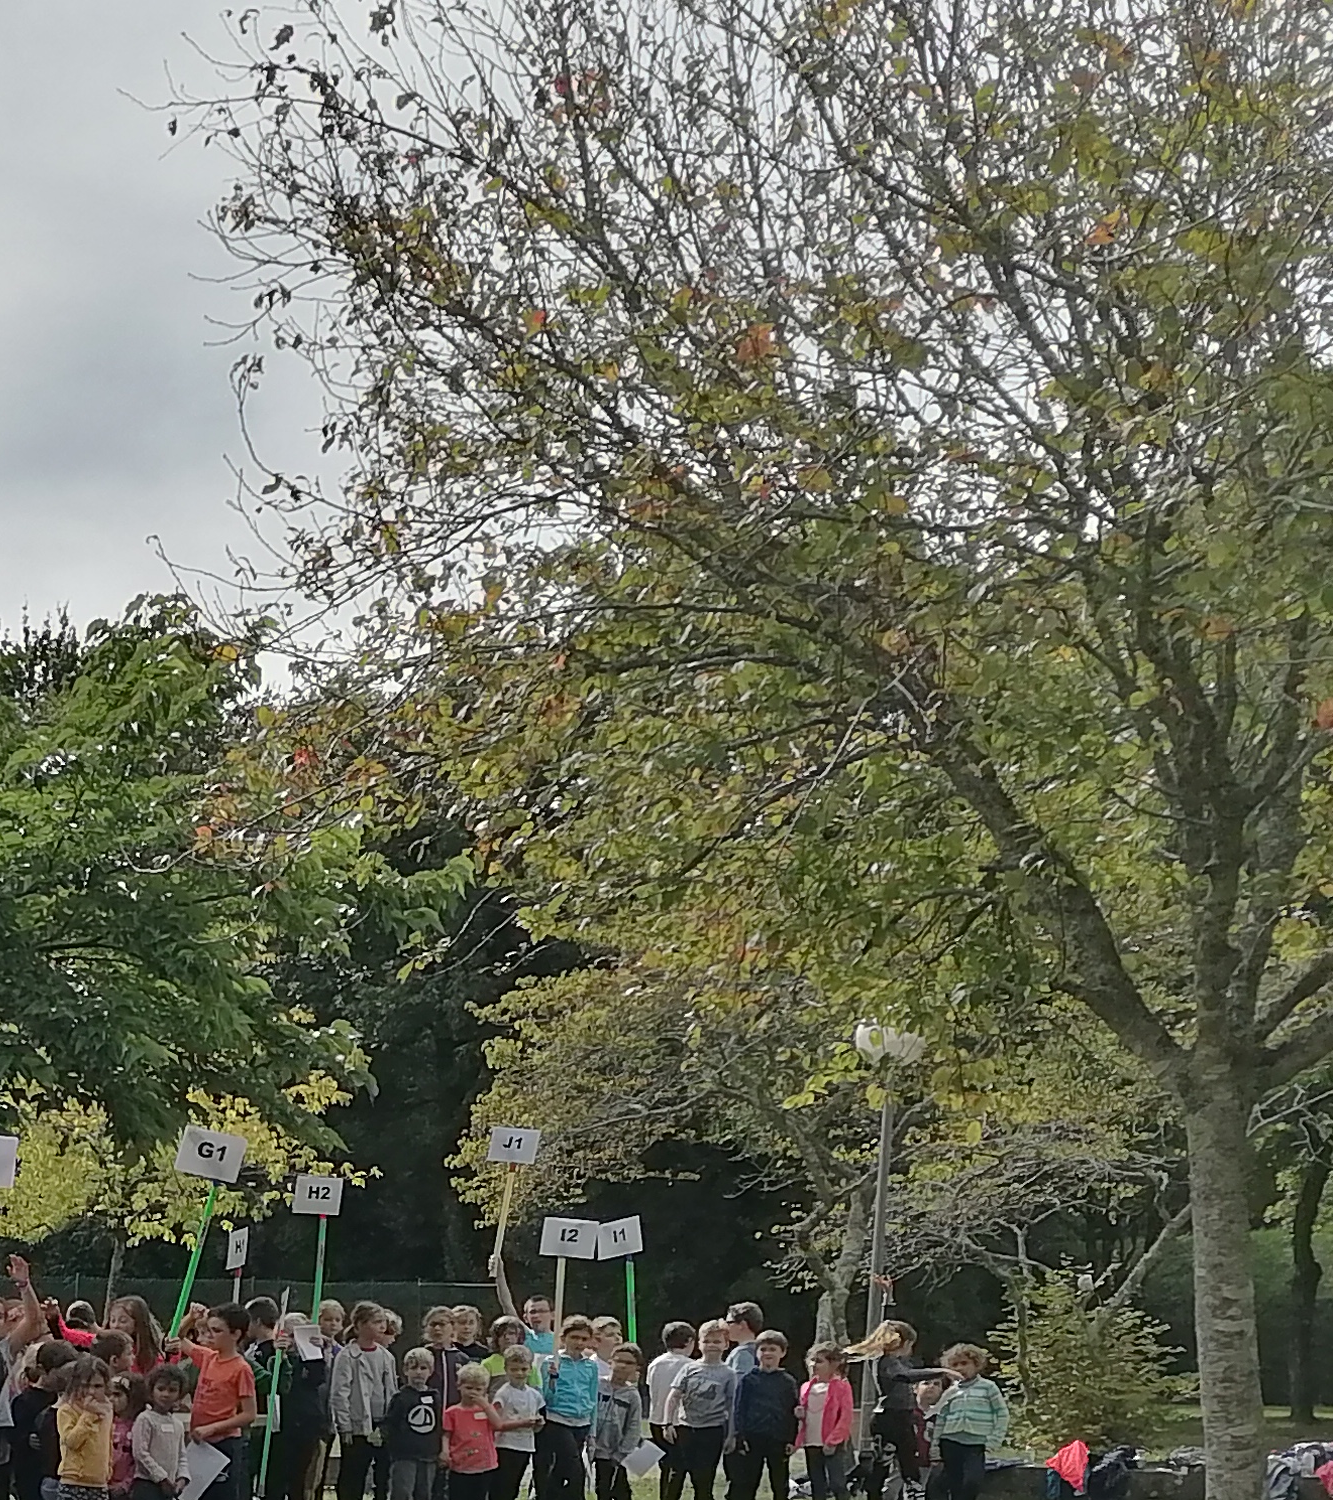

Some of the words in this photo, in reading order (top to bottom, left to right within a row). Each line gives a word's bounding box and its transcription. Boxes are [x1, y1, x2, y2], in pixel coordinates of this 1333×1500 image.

[502, 1136, 523, 1150] J1
[197, 1141, 227, 1162] G1
[307, 1185, 331, 1200] H2
[560, 1228, 579, 1243] I2
[613, 1227, 626, 1243] I1
